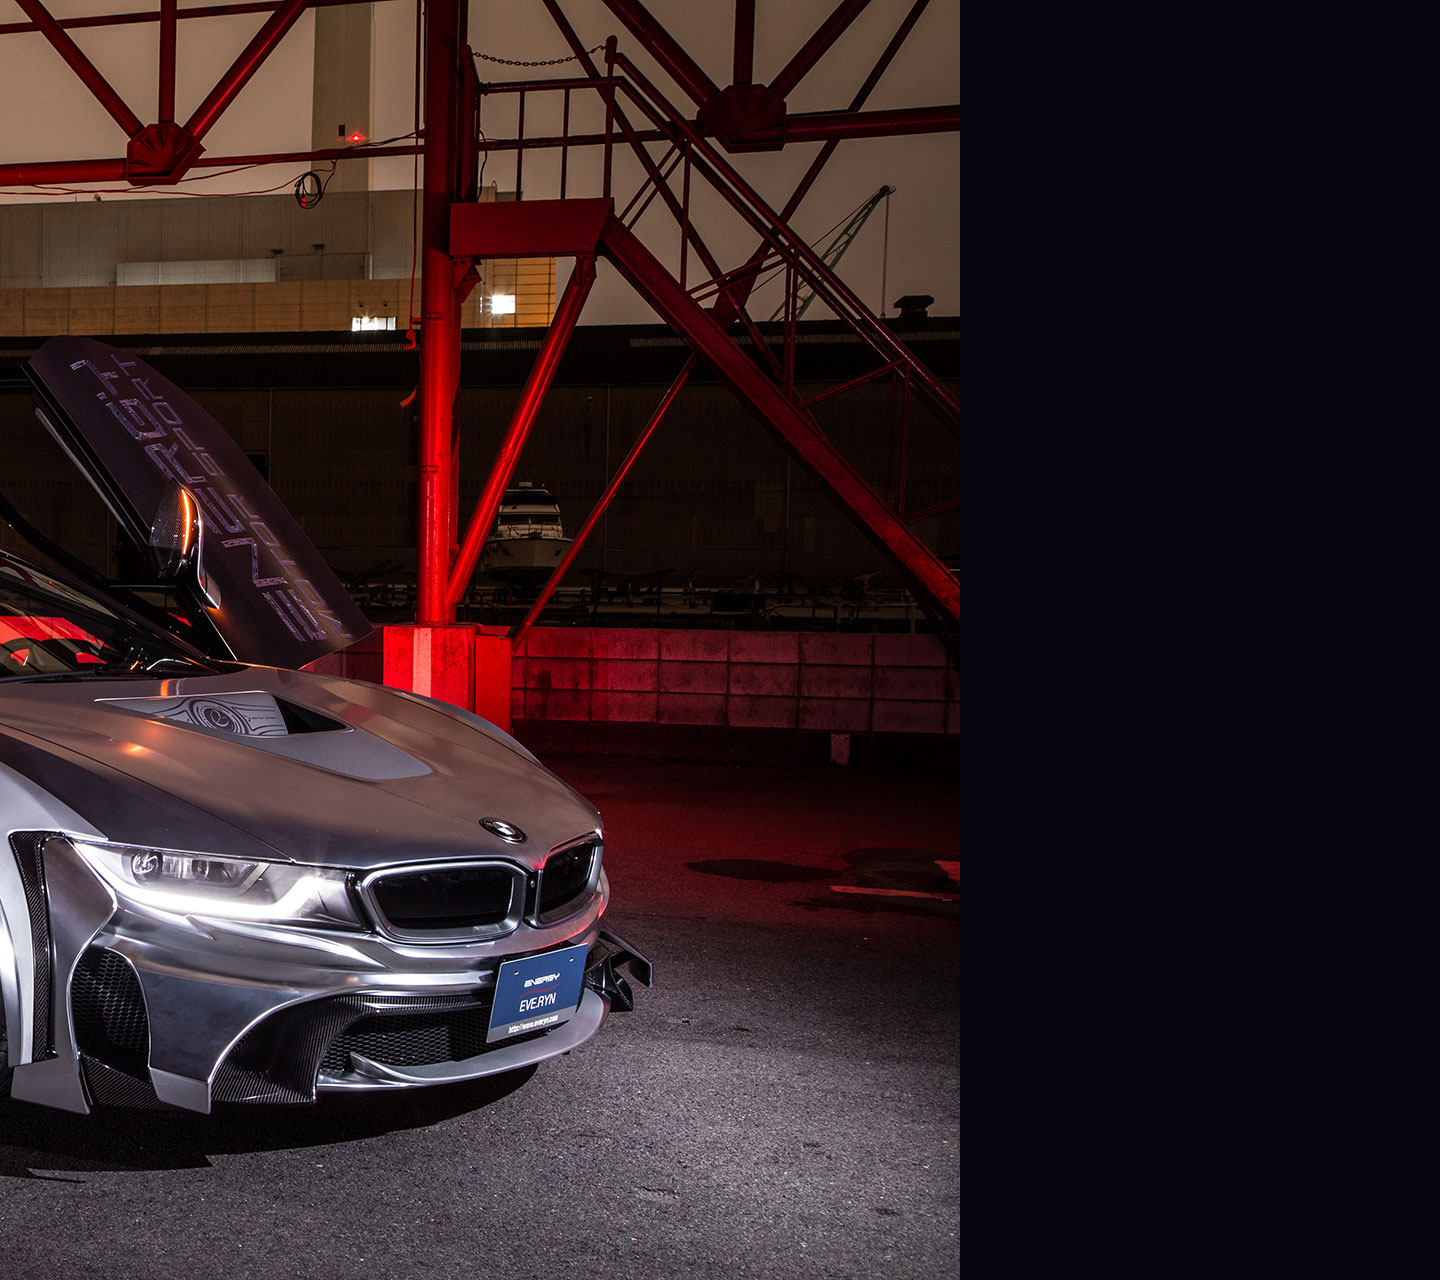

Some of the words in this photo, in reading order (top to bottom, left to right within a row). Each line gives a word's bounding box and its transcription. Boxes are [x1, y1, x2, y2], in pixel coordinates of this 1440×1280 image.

[110, 353, 227, 476] SPORT
[69, 359, 329, 642] ENERGY
[227, 493, 353, 638] MOTOR
[523, 972, 561, 988] ENERGY
